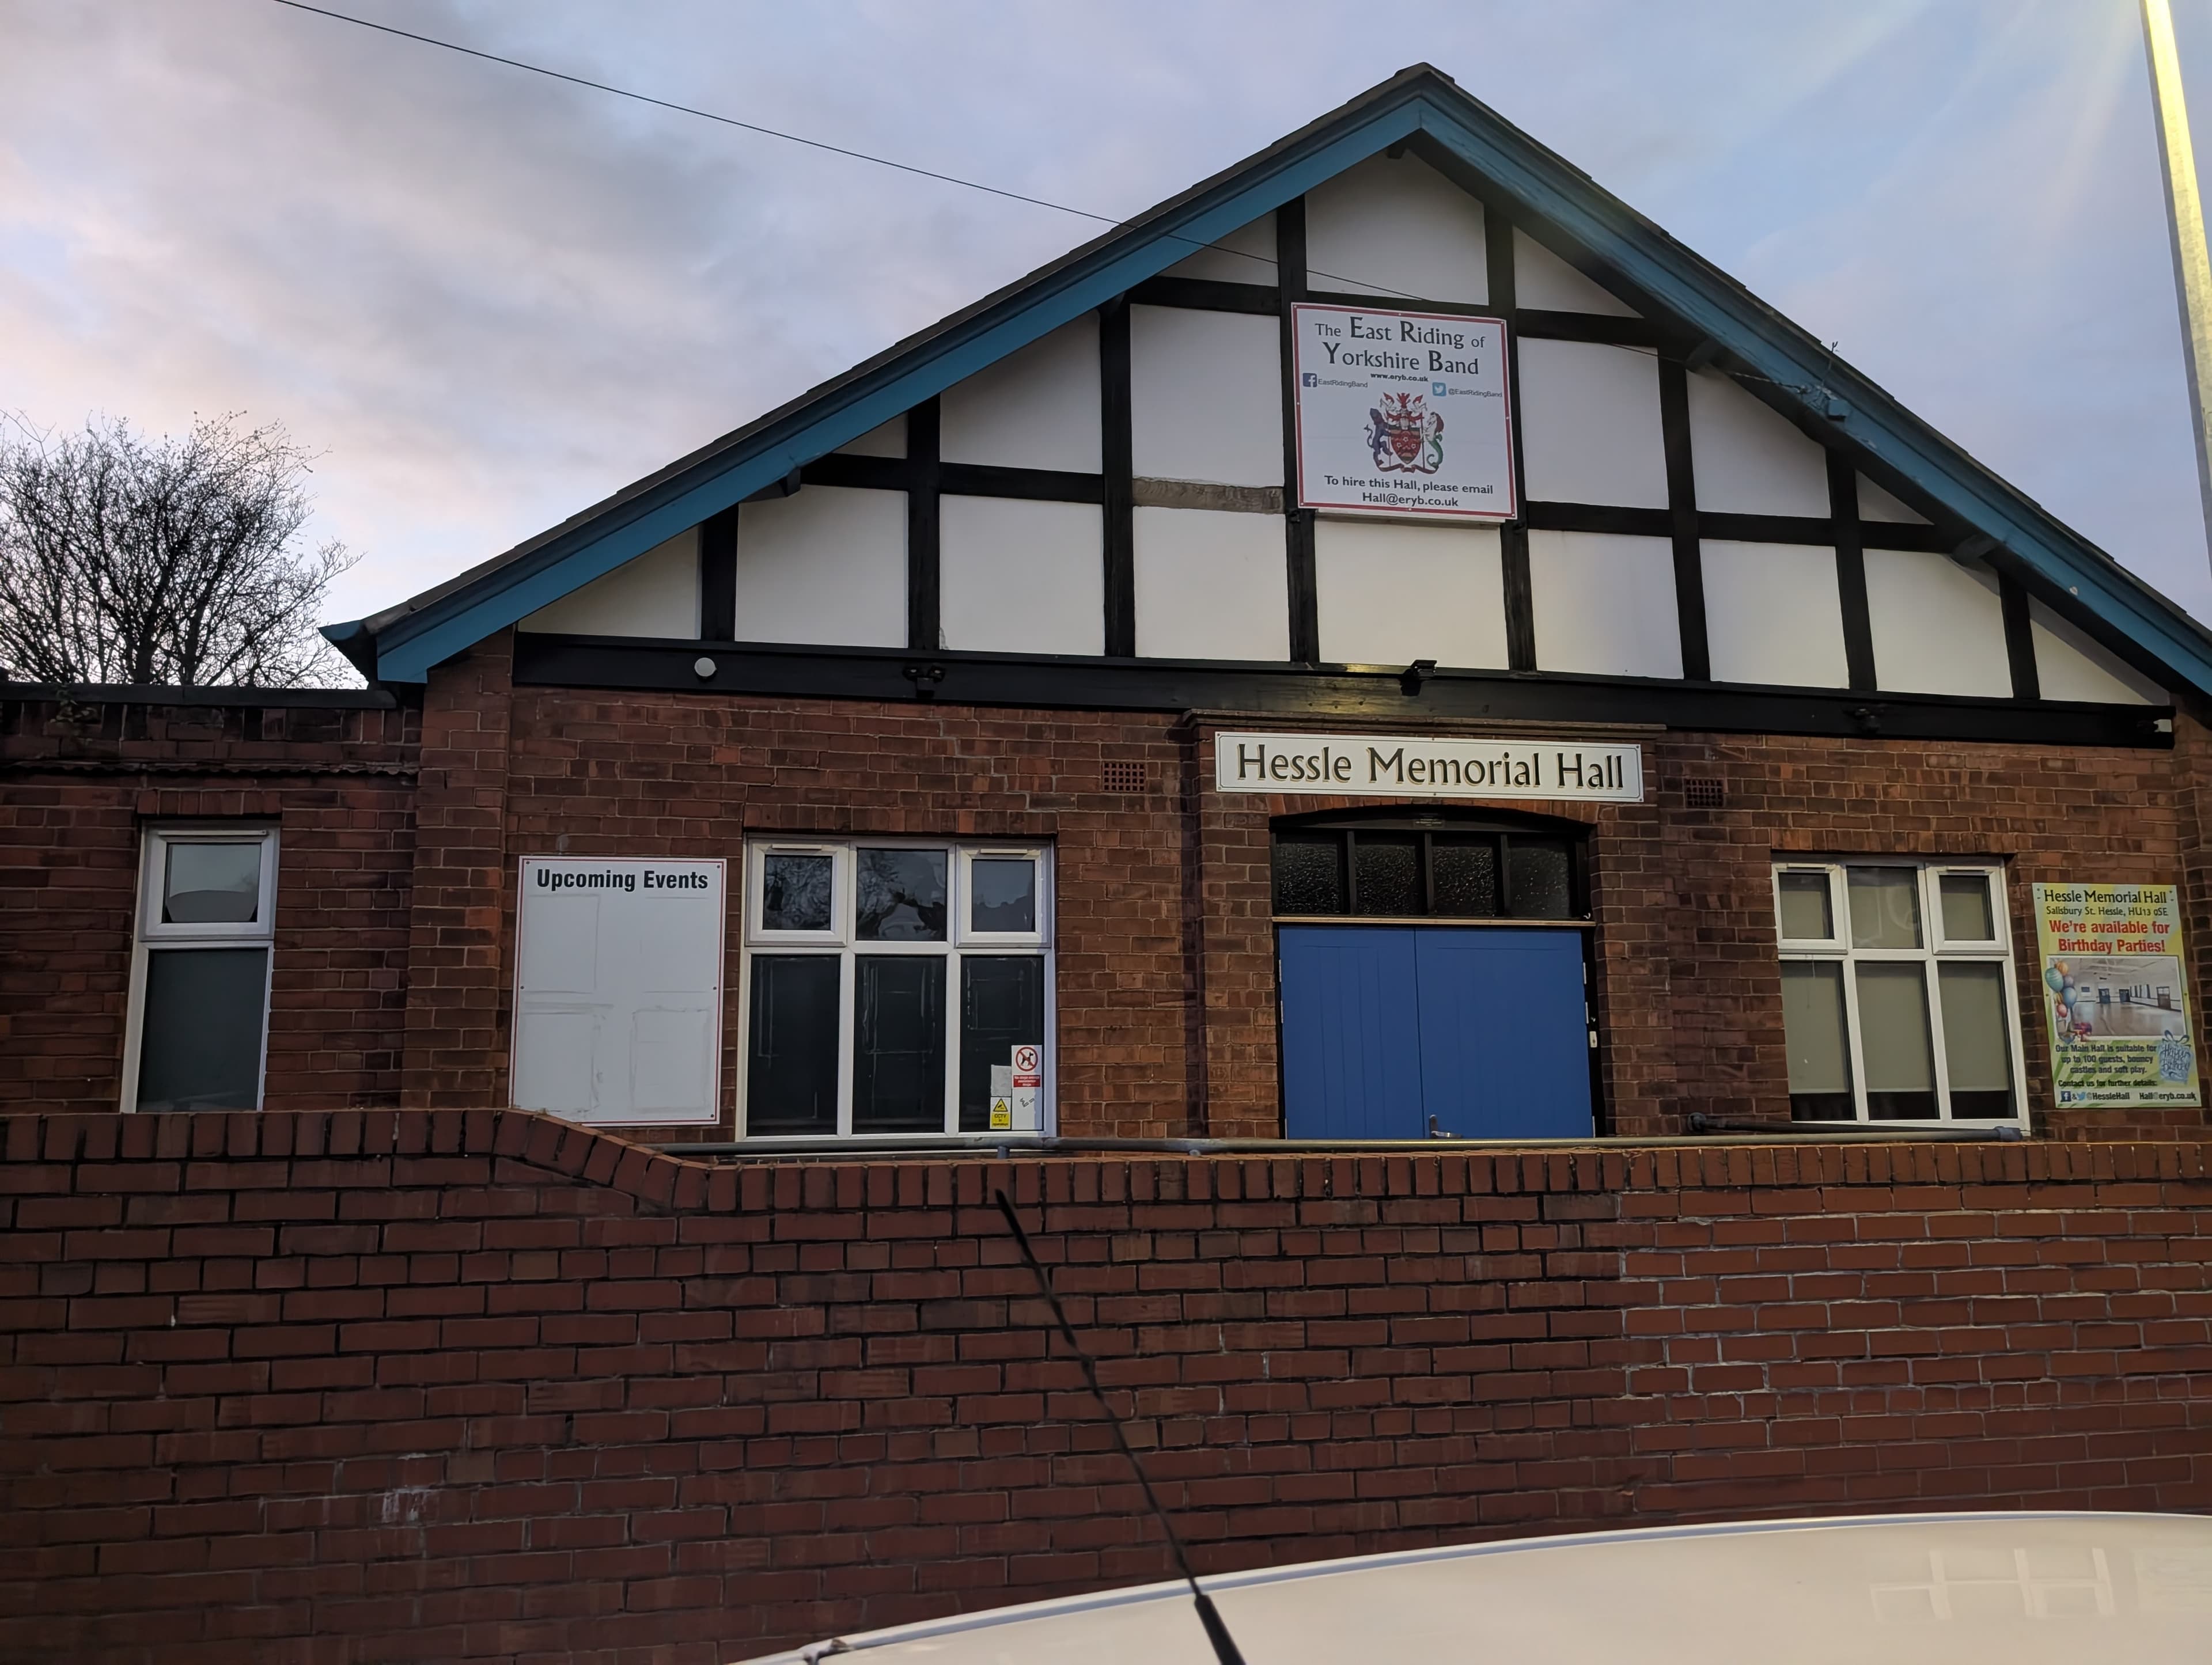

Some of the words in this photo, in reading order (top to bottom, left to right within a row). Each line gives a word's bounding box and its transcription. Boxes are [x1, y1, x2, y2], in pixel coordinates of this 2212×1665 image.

[1315, 323, 1341, 336] The
[1350, 316, 1392, 340] East
[1400, 321, 1464, 349] Riding
[1471, 336, 1486, 348] of
[1322, 342, 1419, 370] Yorkshire
[1429, 350, 1479, 374] Band
[1318, 379, 1368, 388] EastRidingBand
[1370, 373, 1429, 382] www.eryb.co.uk
[1324, 475, 1338, 485] To
[1343, 477, 1365, 486] hire
[1369, 478, 1390, 488] this
[1394, 480, 1420, 491] Hall,
[1423, 481, 1459, 493] please
[1462, 485, 1493, 494] email
[1362, 492, 1459, 506] Hall@eryb.co.uk
[1237, 744, 1352, 783] Hessle
[1366, 747, 1540, 787] Memorial
[1556, 752, 1624, 790] Hall
[537, 868, 635, 892] Upcoming
[643, 870, 709, 889] Events
[2044, 889, 2082, 902] Hessle
[2084, 890, 2141, 903] Memorial
[2143, 891, 2166, 904] Hall
[2046, 906, 2082, 916] Salisbury
[2099, 907, 2126, 916] Hessle,
[2128, 907, 2151, 916] HU13
[2049, 920, 2086, 933] We're
[2091, 921, 2148, 934] available
[2152, 921, 2170, 934] for
[2058, 939, 2113, 954] Birthday
[2117, 939, 2166, 952] Parties!
[2127, 1055, 2153, 1064] bouncy
